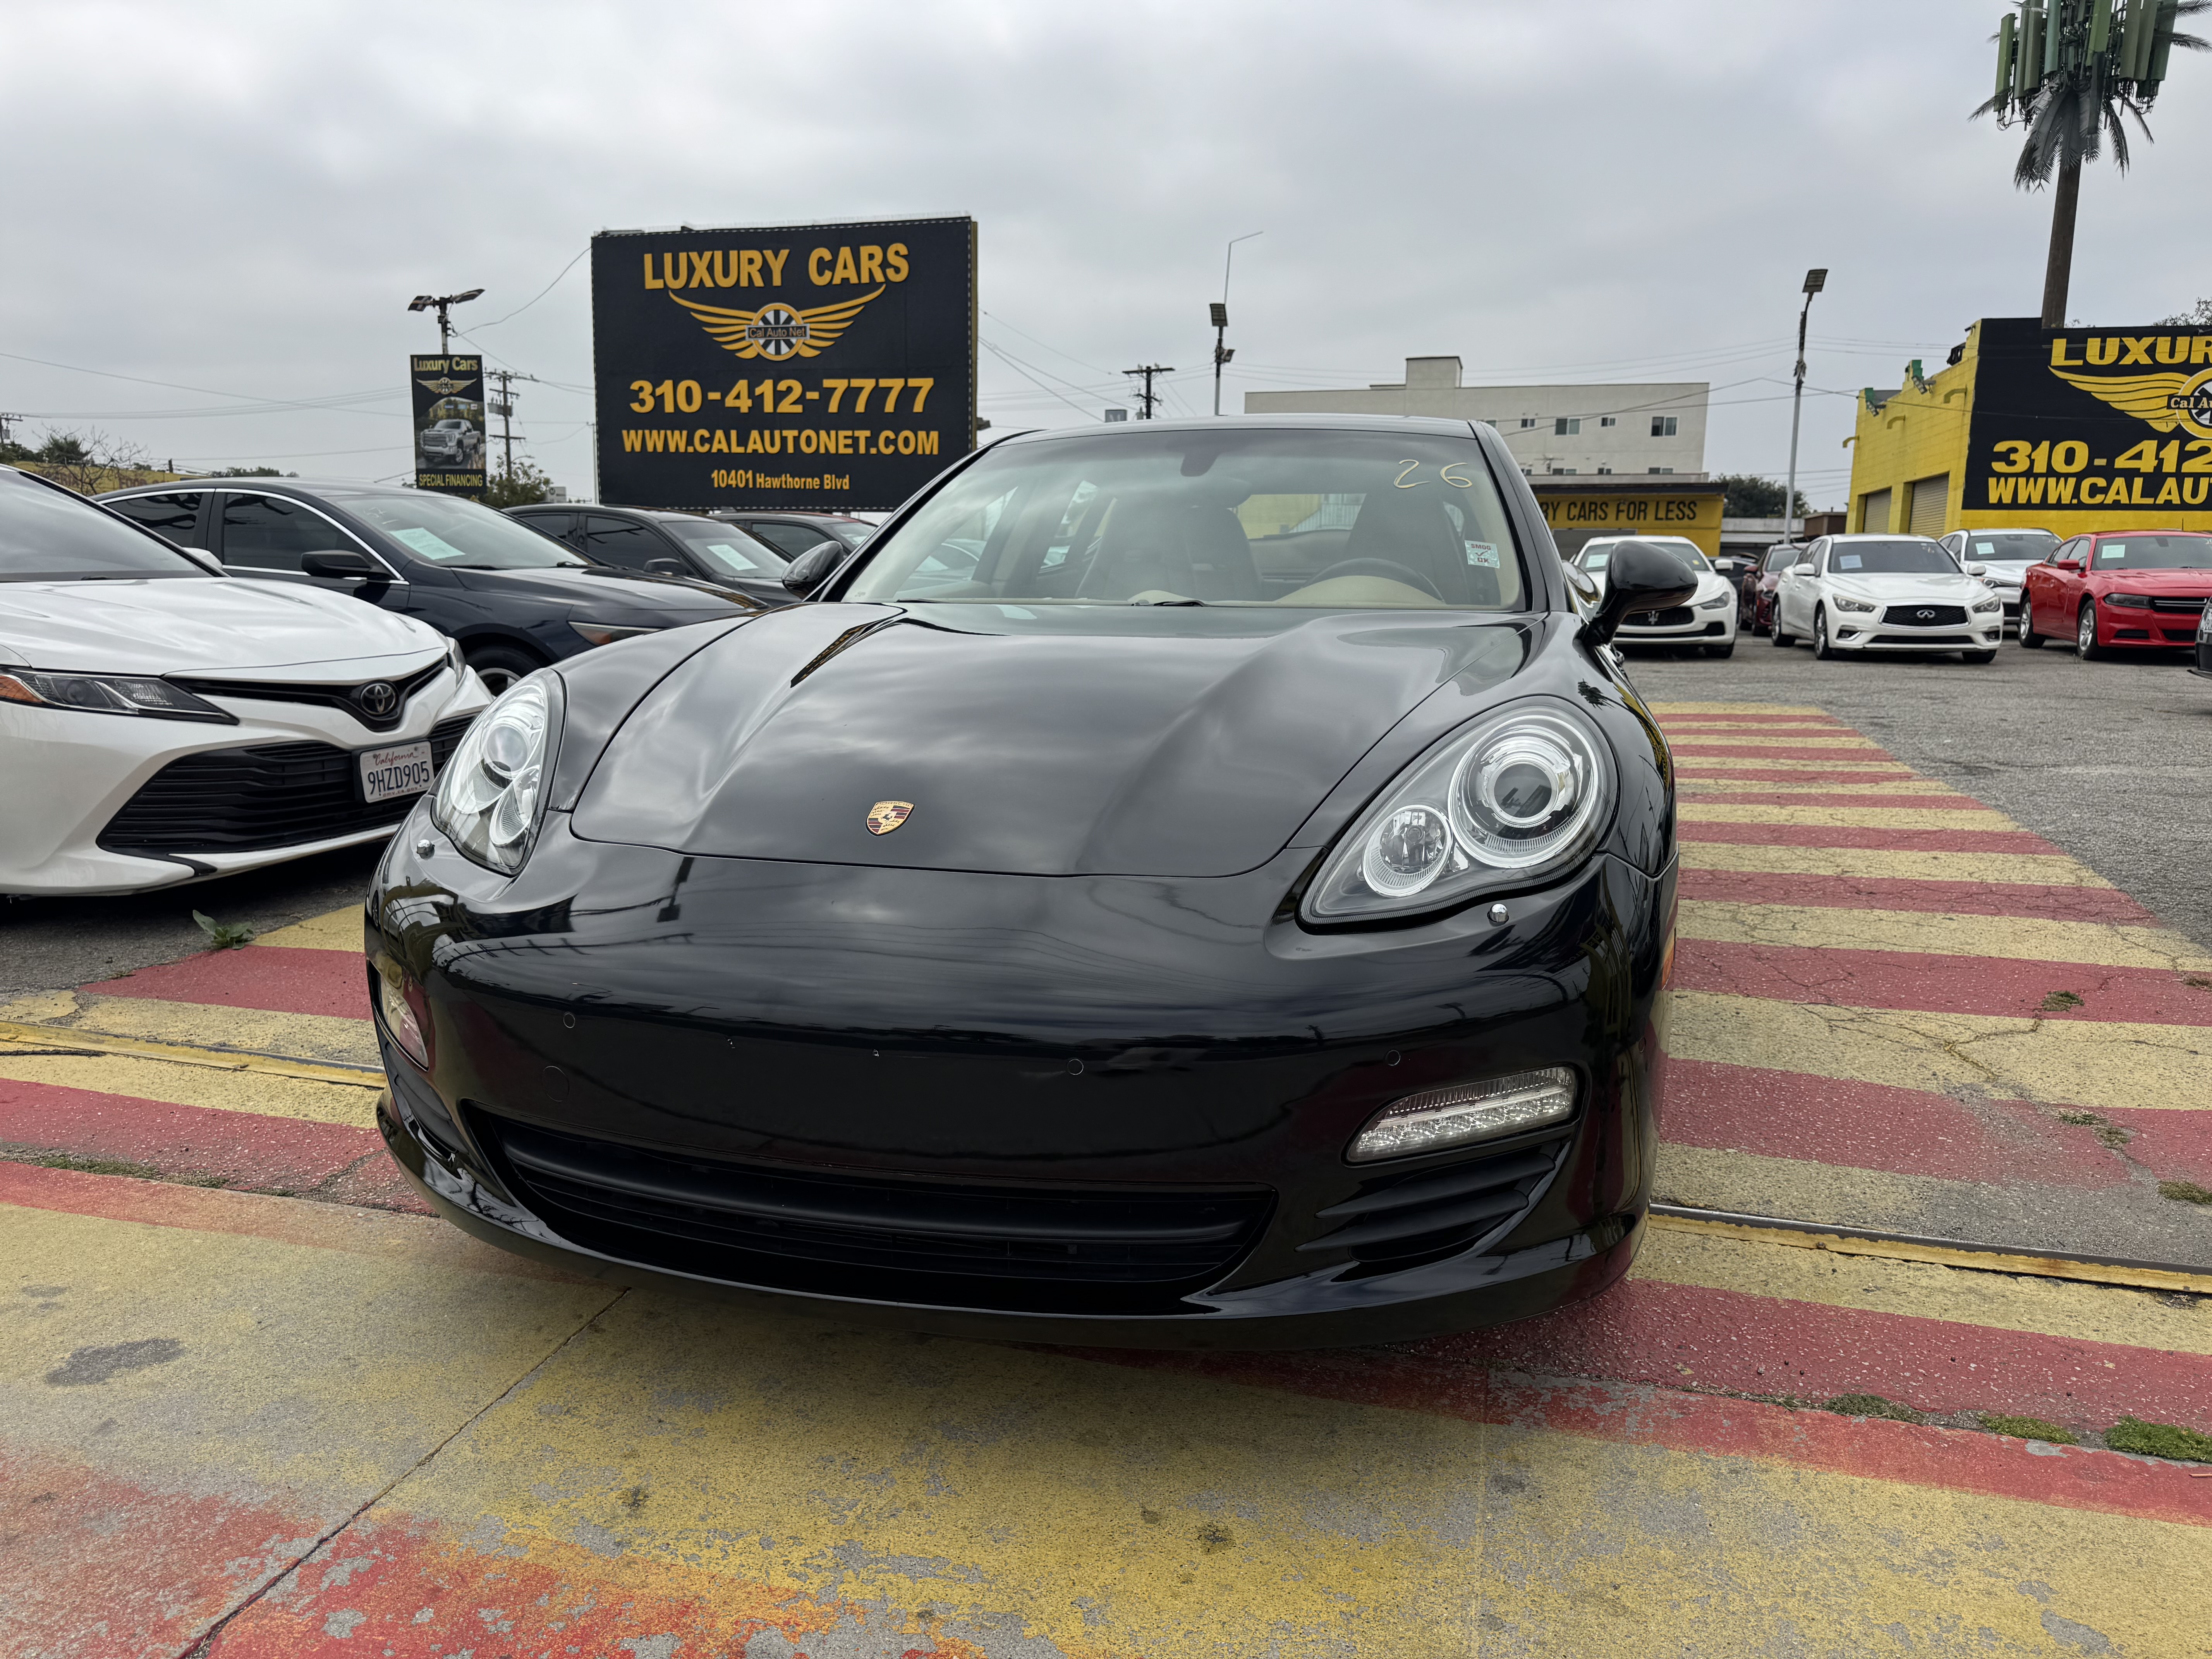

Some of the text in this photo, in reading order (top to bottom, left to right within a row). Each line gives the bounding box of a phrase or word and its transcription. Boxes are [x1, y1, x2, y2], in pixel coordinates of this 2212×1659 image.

[644, 243, 909, 289] LUXURY CARS
[749, 327, 805, 338] Cal Auto Net
[414, 357, 478, 374] Luxury Cars
[630, 378, 934, 413] 310-412-7777
[2171, 397, 2194, 408] Cal
[622, 429, 939, 455] WWW.CALAUTONET.COM
[419, 474, 483, 487] SPECIAL FINANCING
[711, 469, 850, 490] 10401 Hawthorne Blvd
[1567, 502, 1609, 521] CARS
[1615, 501, 1648, 521] FOR
[1654, 501, 1697, 520] LESS
[375, 751, 419, 766] California
[368, 761, 430, 795] 9HZD905
